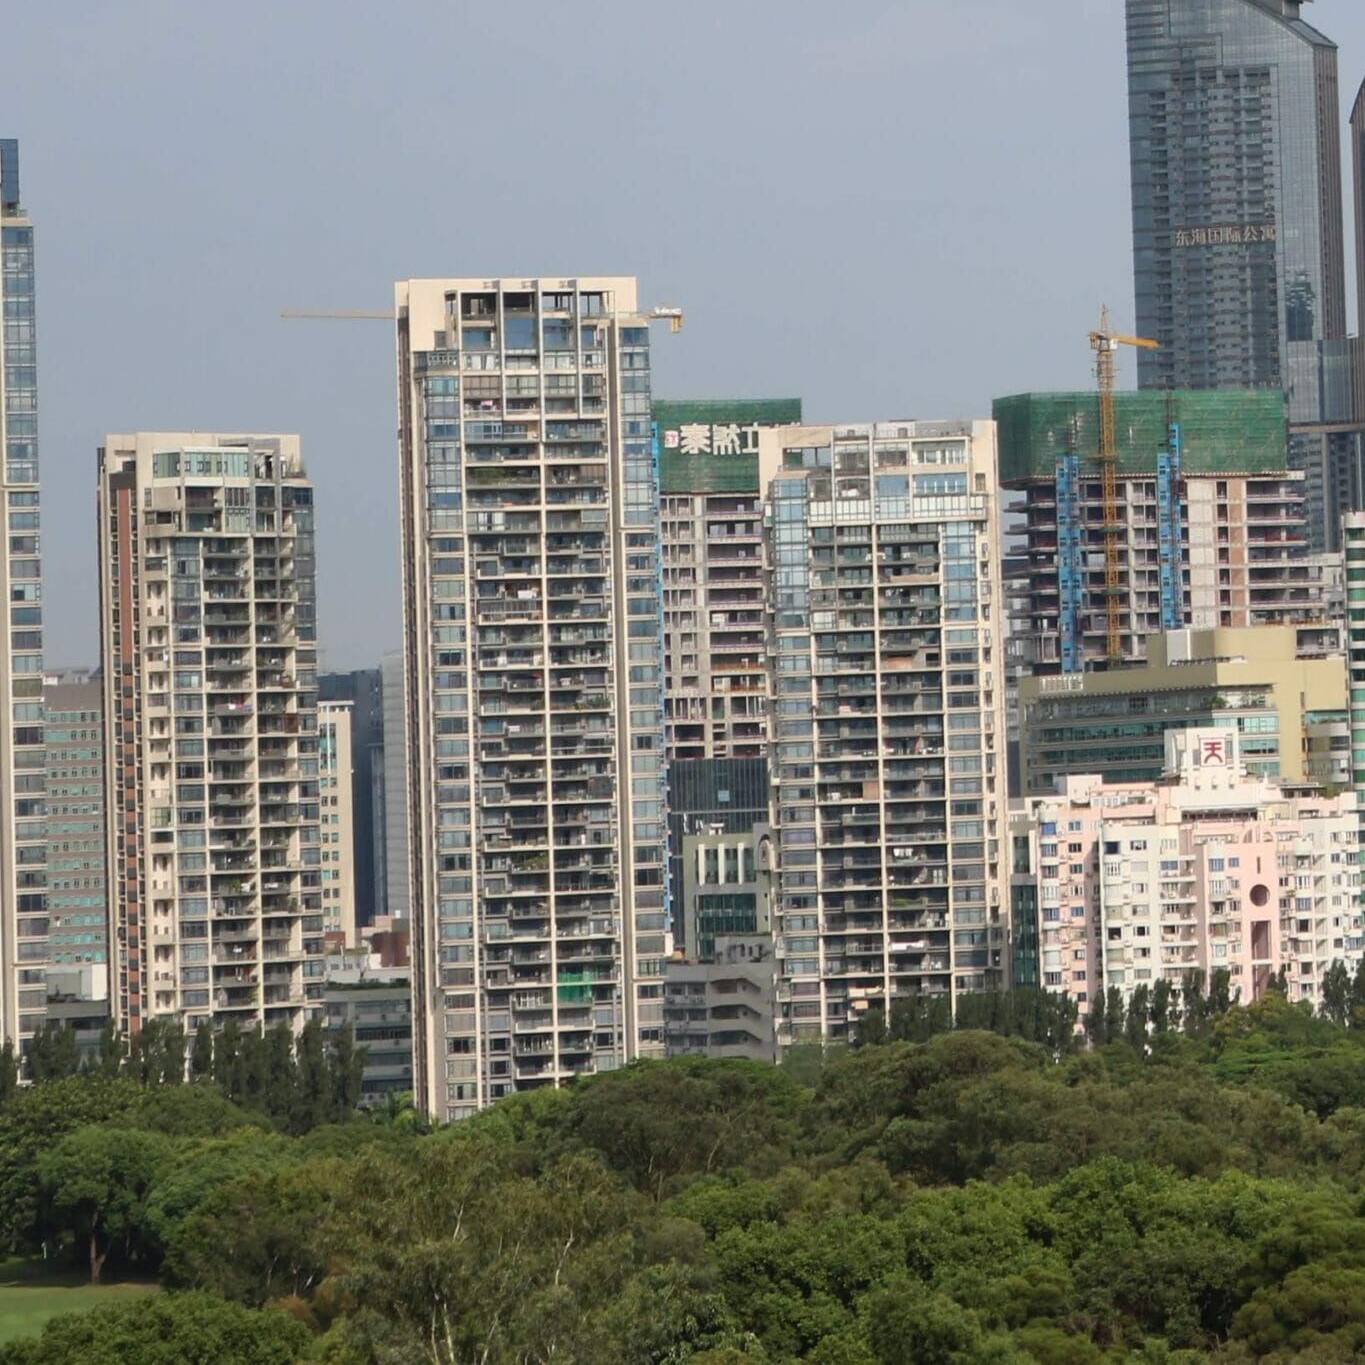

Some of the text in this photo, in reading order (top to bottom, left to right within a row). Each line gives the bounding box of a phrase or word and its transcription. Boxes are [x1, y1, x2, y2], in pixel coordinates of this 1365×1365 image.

[1176, 225, 1275, 246] 东海国际公寓
[680, 422, 802, 455] 泰然立
